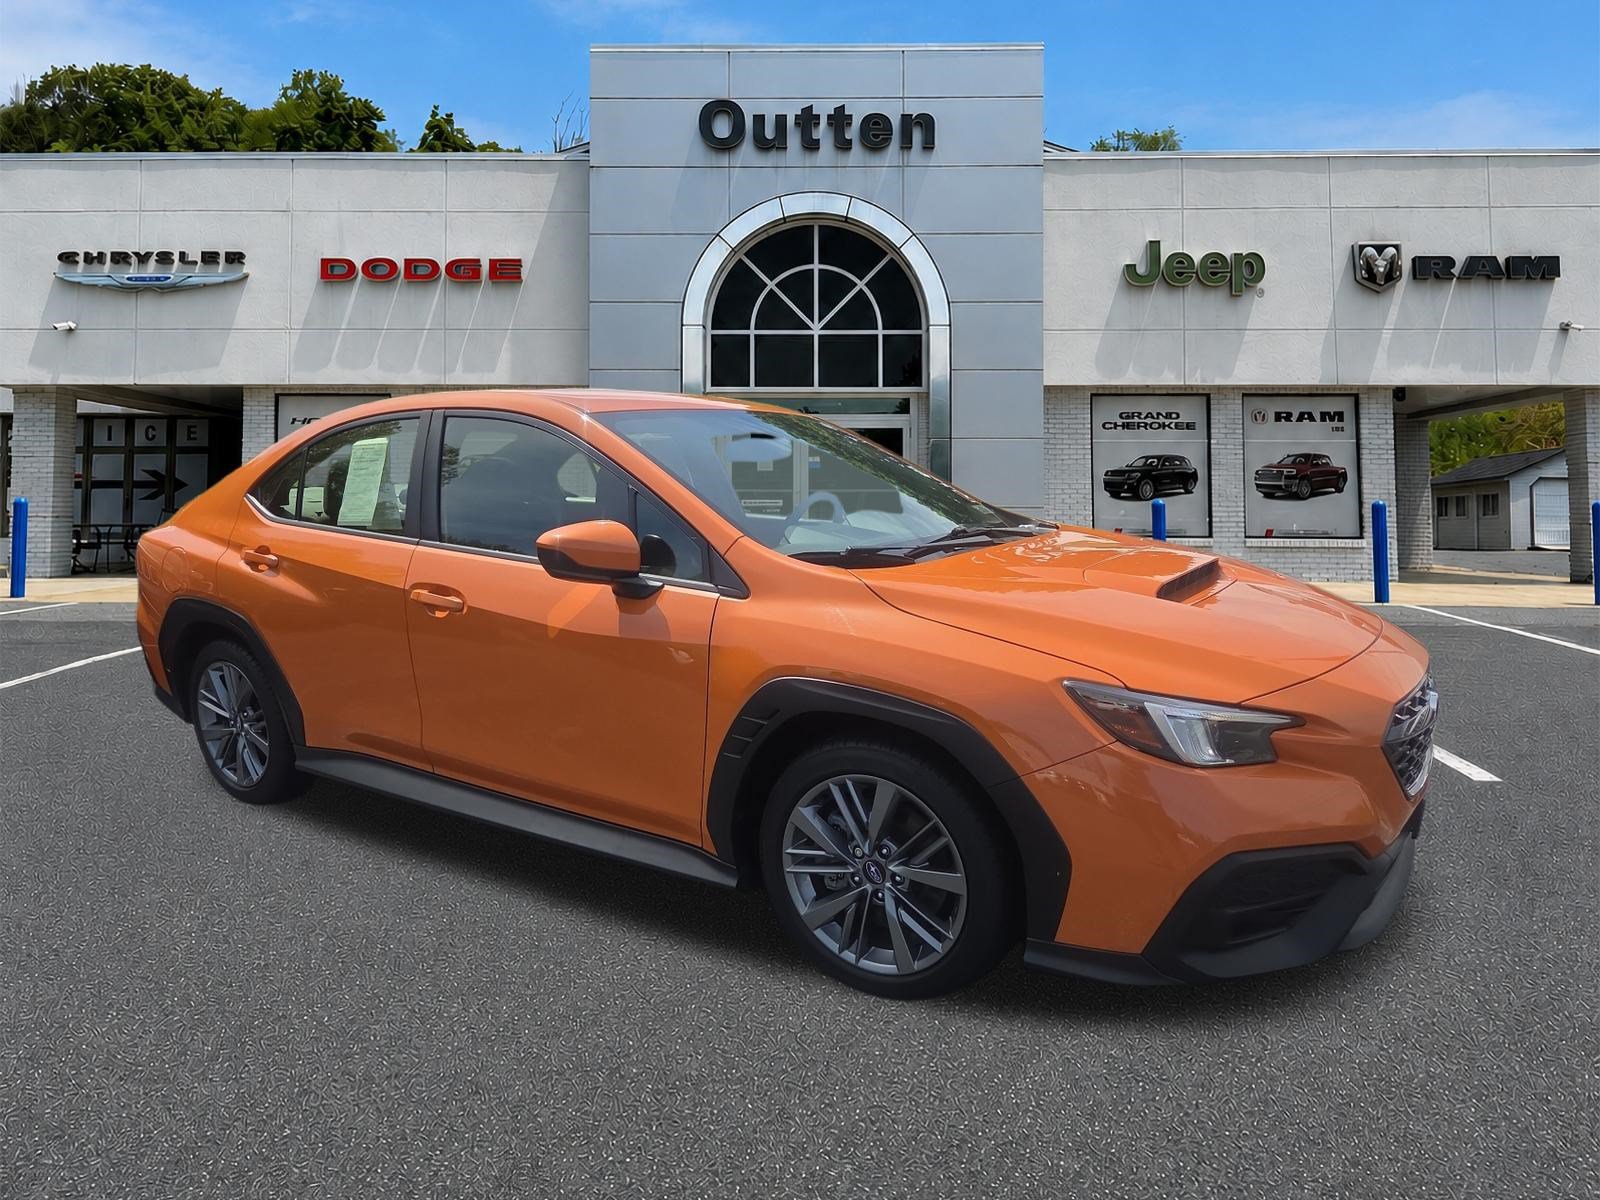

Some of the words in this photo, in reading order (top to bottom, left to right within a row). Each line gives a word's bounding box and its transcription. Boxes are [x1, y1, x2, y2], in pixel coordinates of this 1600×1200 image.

[698, 99, 936, 150] Outten
[57, 251, 247, 266] CHRYSLER
[1123, 239, 1266, 297] Jeep
[1411, 255, 1561, 281] RAM
[319, 257, 523, 282] DODGE
[1118, 411, 1181, 420] GRAND
[1274, 411, 1345, 423] RAM
[1102, 421, 1197, 431] CHEROKEE
